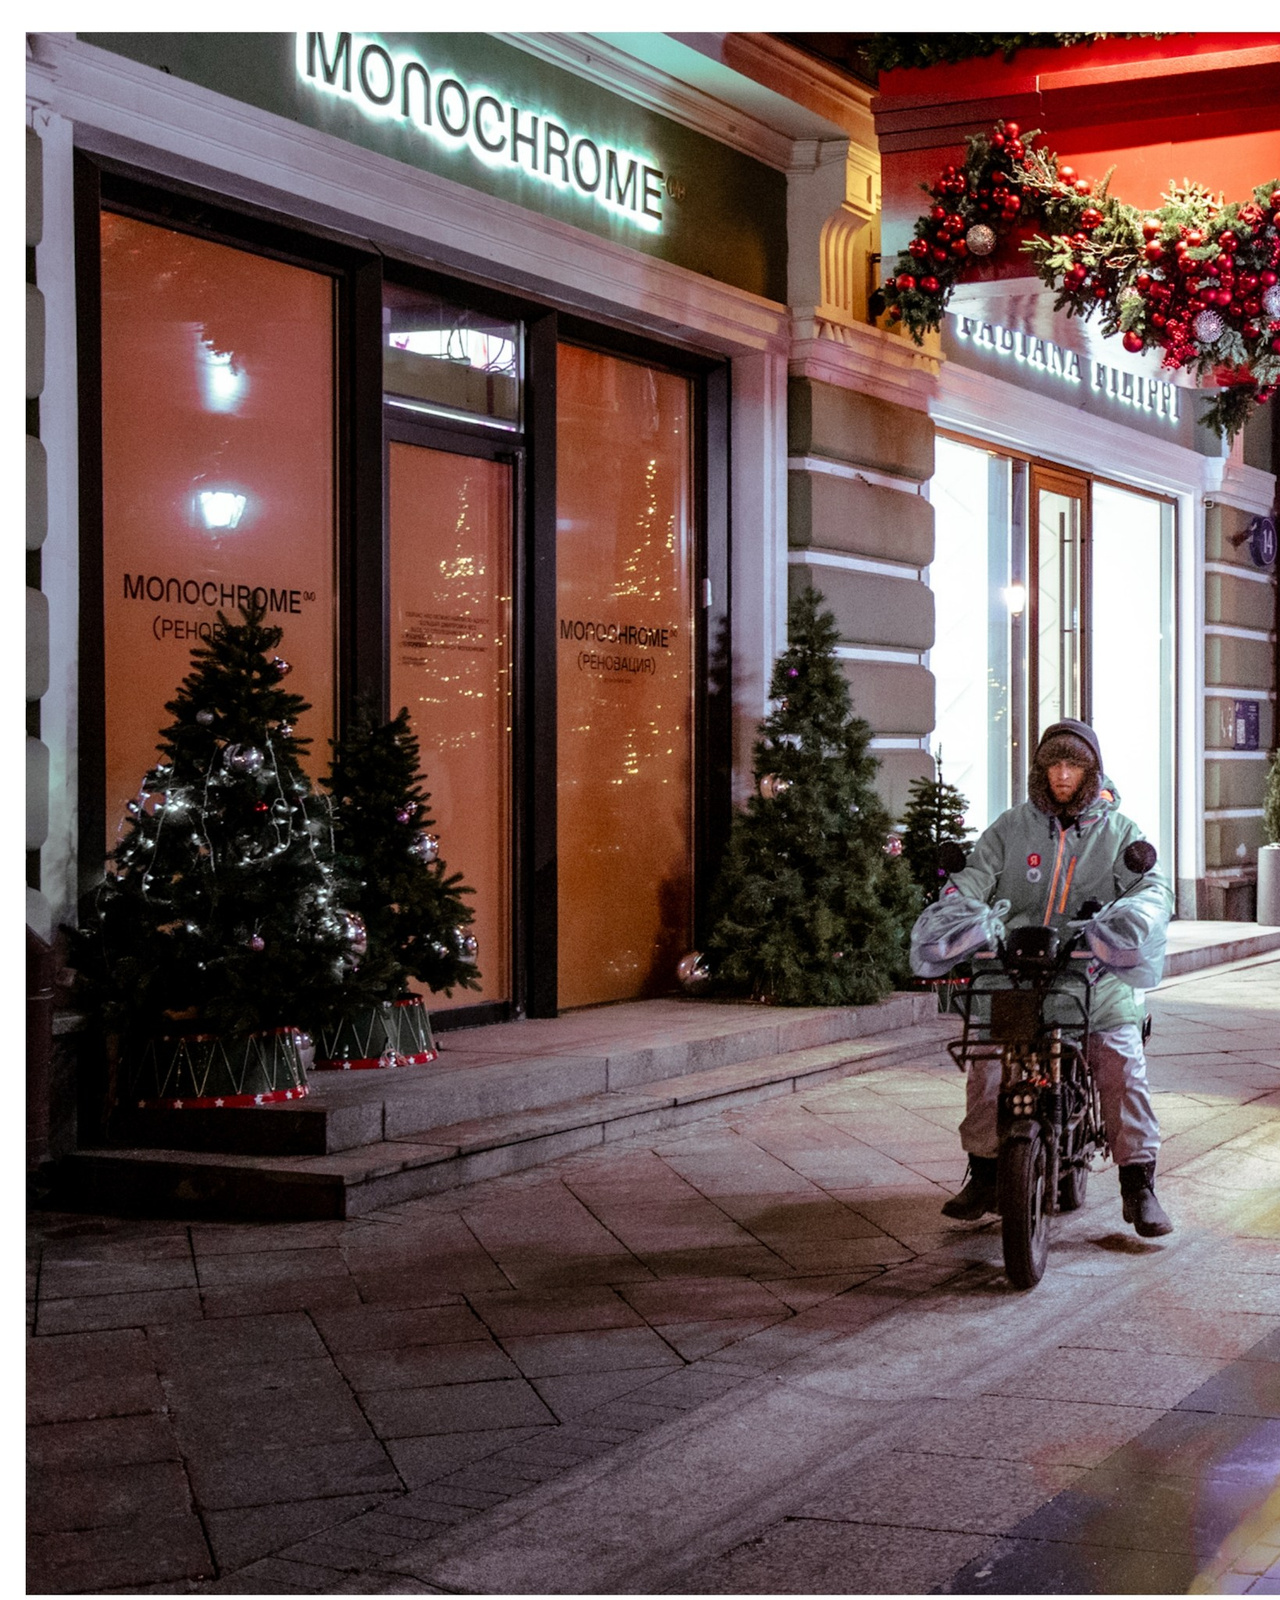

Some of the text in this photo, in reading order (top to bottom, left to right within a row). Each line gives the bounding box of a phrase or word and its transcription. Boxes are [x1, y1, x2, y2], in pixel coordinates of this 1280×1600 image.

[1263, 529, 1273, 555] 14
[577, 652, 656, 675] (РЕНОВАЦИЯ)
[1030, 855, 1039, 866] Я
